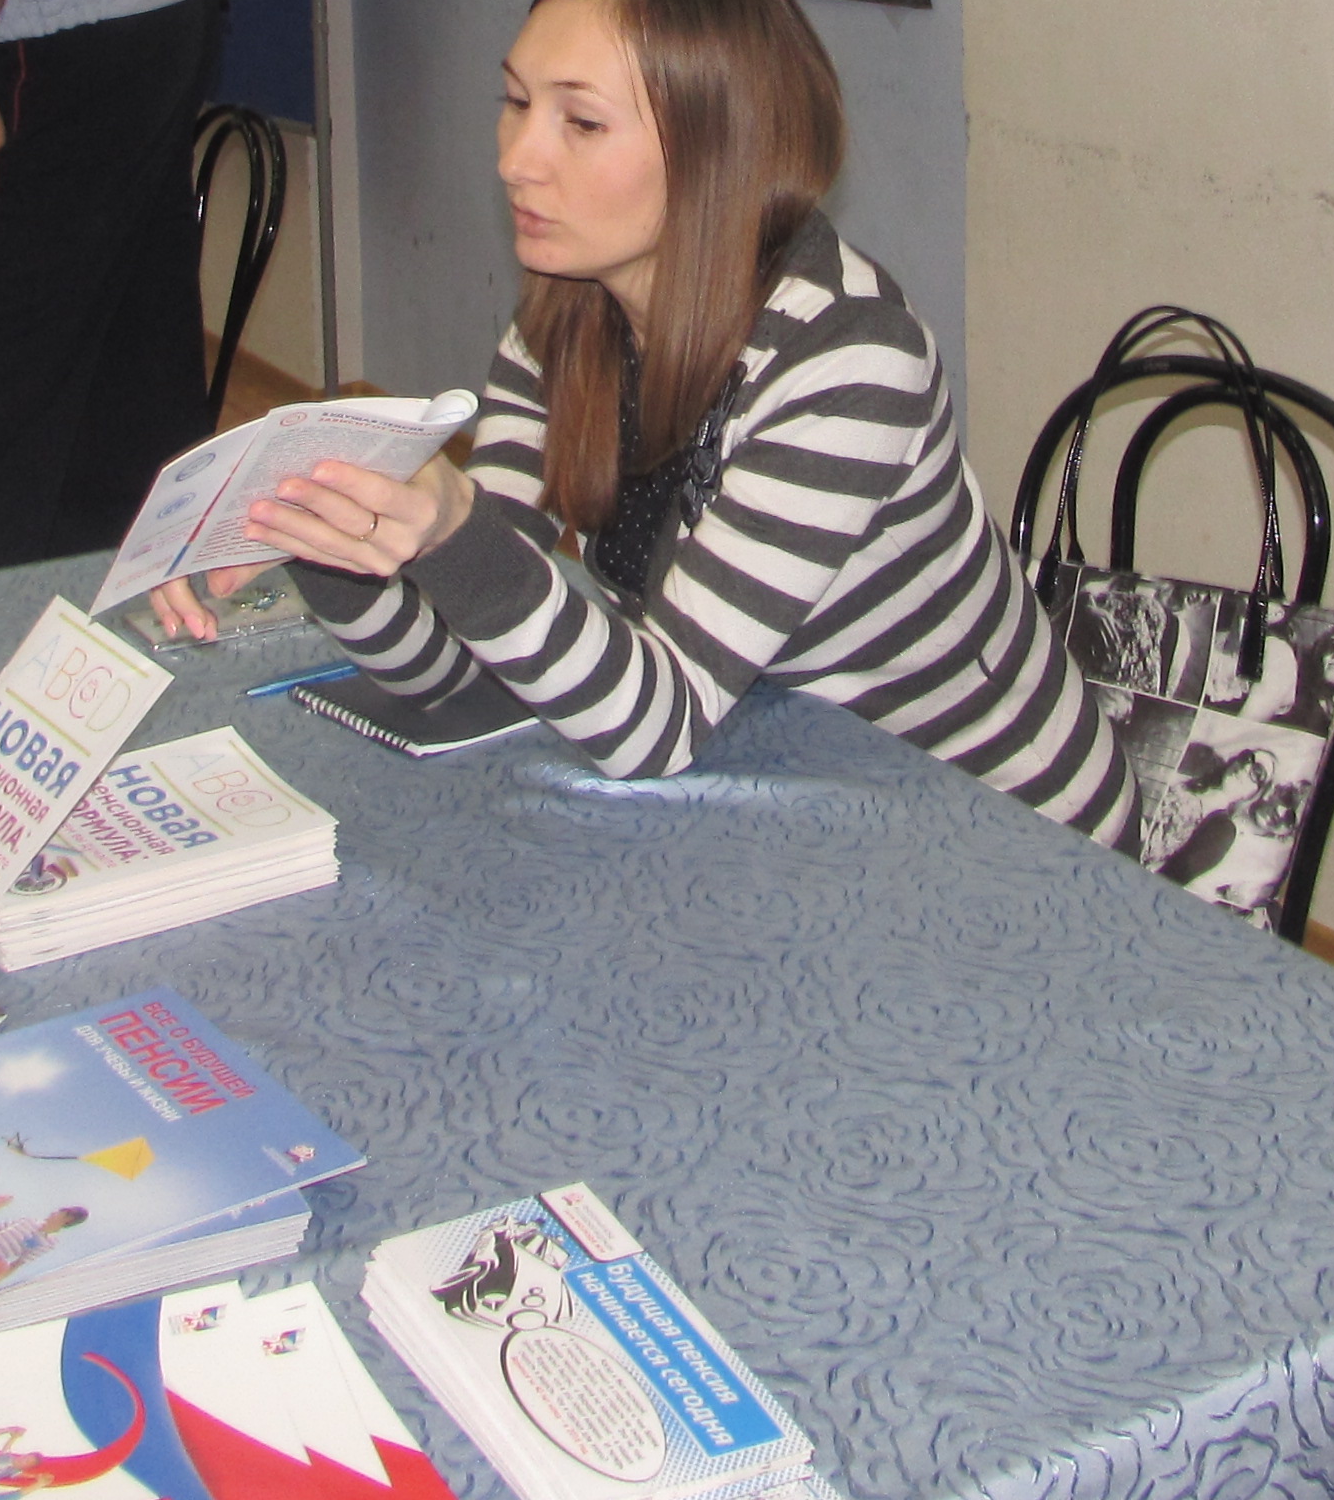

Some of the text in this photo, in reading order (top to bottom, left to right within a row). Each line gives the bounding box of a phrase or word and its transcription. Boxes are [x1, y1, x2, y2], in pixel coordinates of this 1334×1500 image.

[73, 1025, 104, 1046] ДЛЯ
[95, 1044, 139, 1084] УЧЕБЫ
[137, 1085, 183, 1122] ЖИЗНИ
[98, 1010, 228, 1115] ПЕНСИИ
[142, 1001, 257, 1099] ВСЕ О БУДУЩЕЙ
[577, 1271, 670, 1366] начинается
[660, 1368, 735, 1446] сегодня
[606, 1262, 739, 1404] Будущая пенсия
